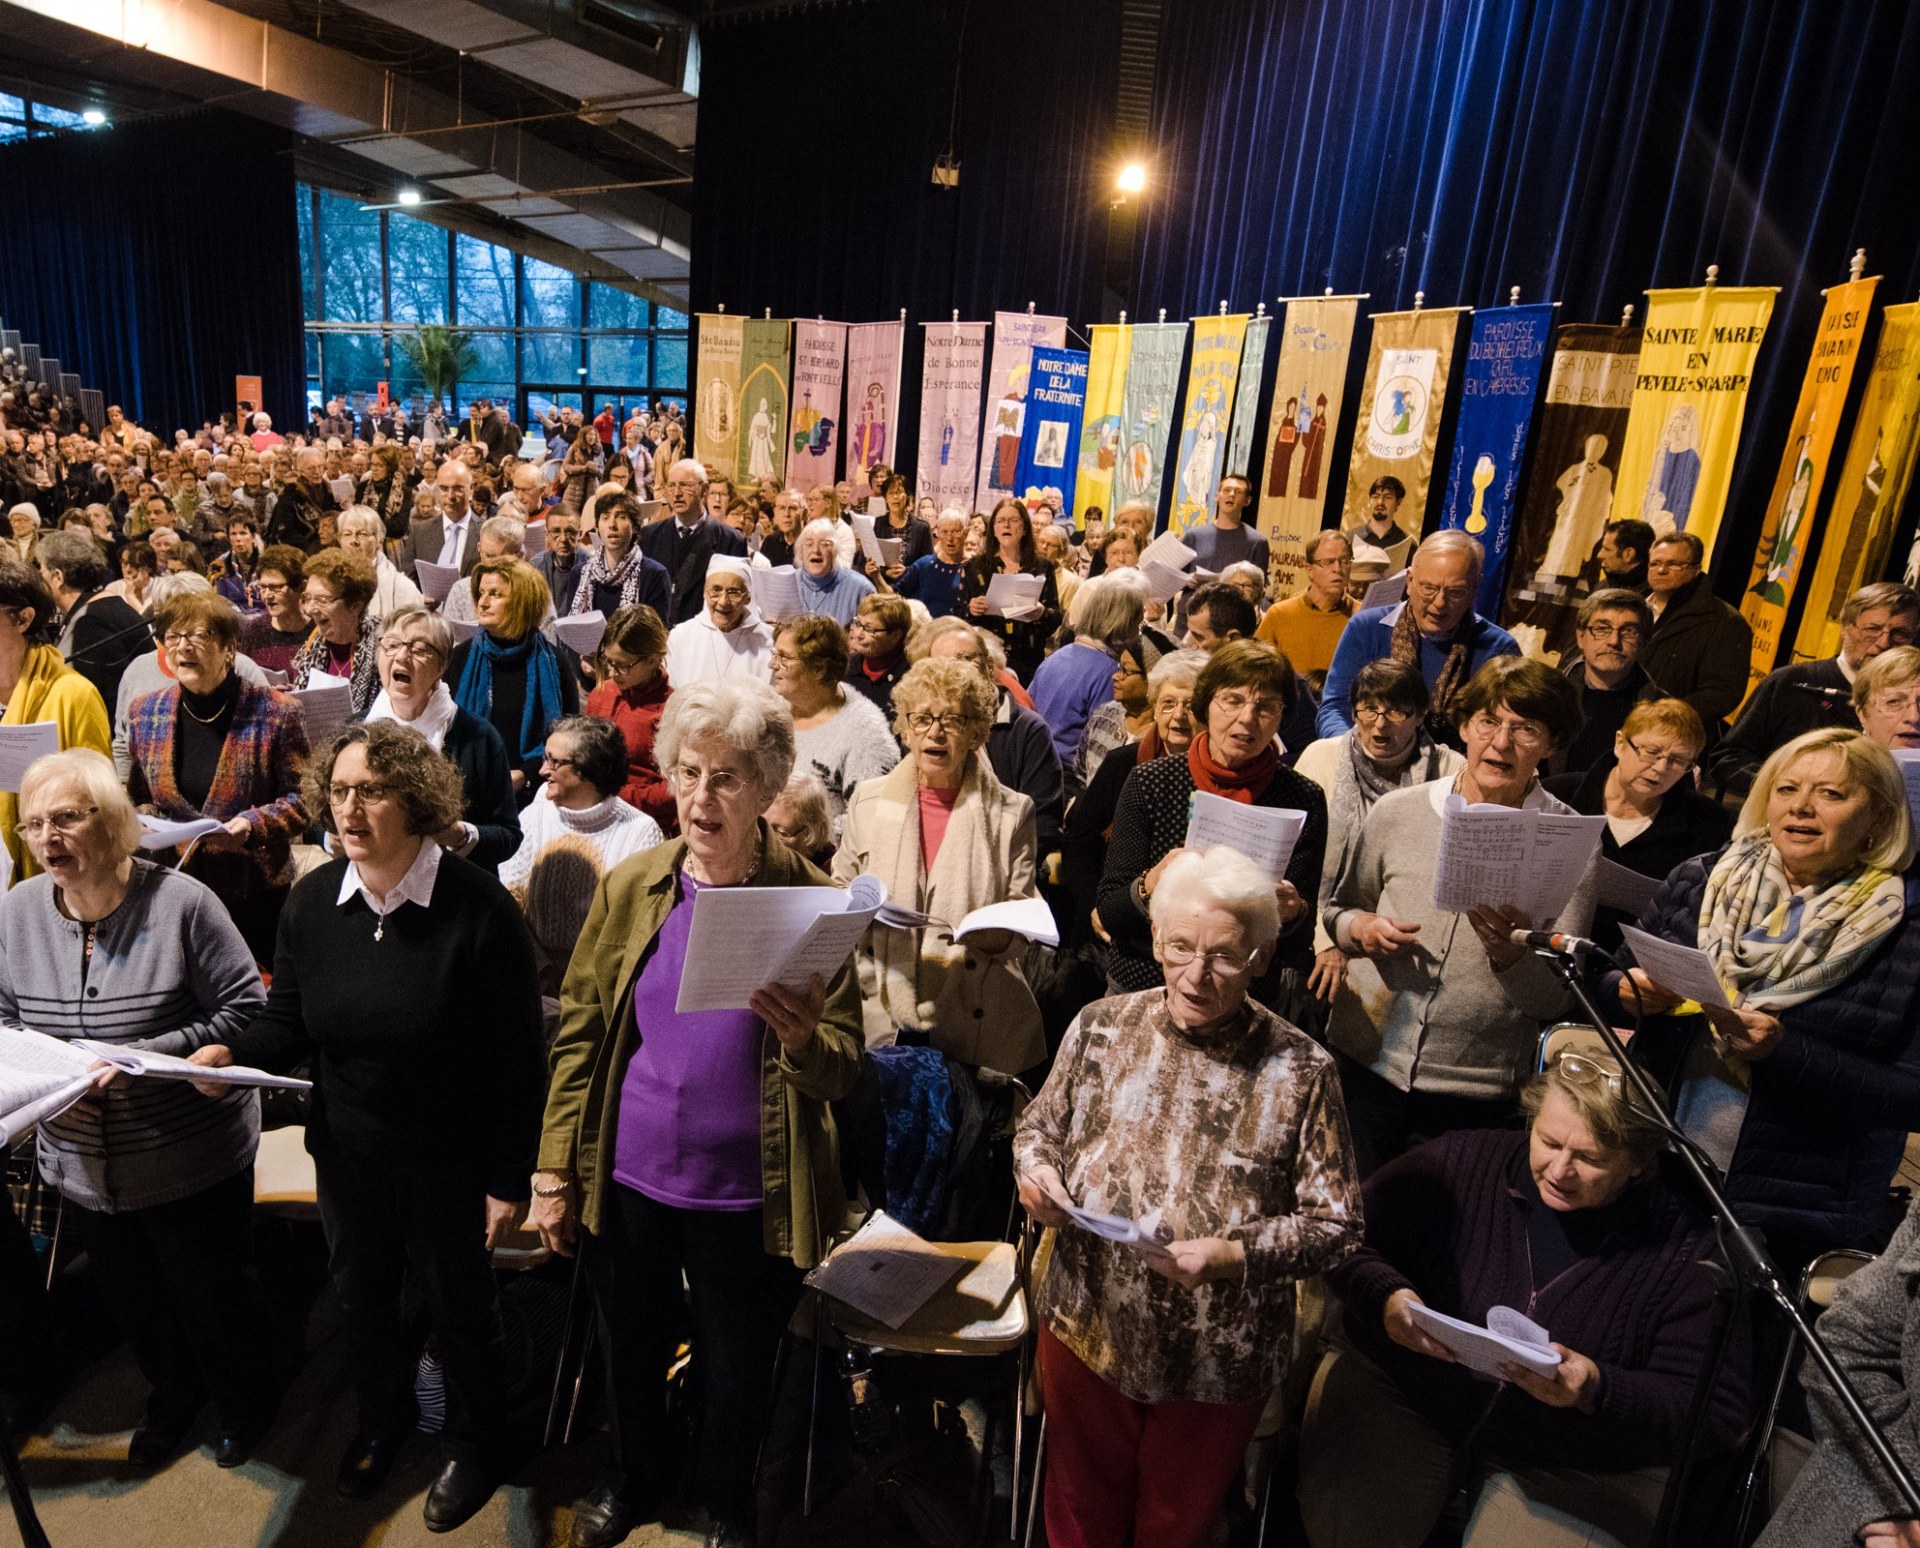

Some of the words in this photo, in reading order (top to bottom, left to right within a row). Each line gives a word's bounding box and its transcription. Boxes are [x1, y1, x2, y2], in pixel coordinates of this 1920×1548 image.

[1484, 320, 1537, 341] PAROISSE
[1644, 327, 1699, 345] SAINTE
[1711, 326, 1764, 344] MARIE
[927, 337, 951, 347] Notre
[952, 336, 984, 348] Dame
[928, 359, 940, 368] de
[945, 359, 979, 369] Bonne
[1038, 359, 1064, 374] NOTRE
[1064, 364, 1088, 377] DAME
[1686, 351, 1711, 369] EN
[1367, 437, 1421, 456] CHRISTOPHE
